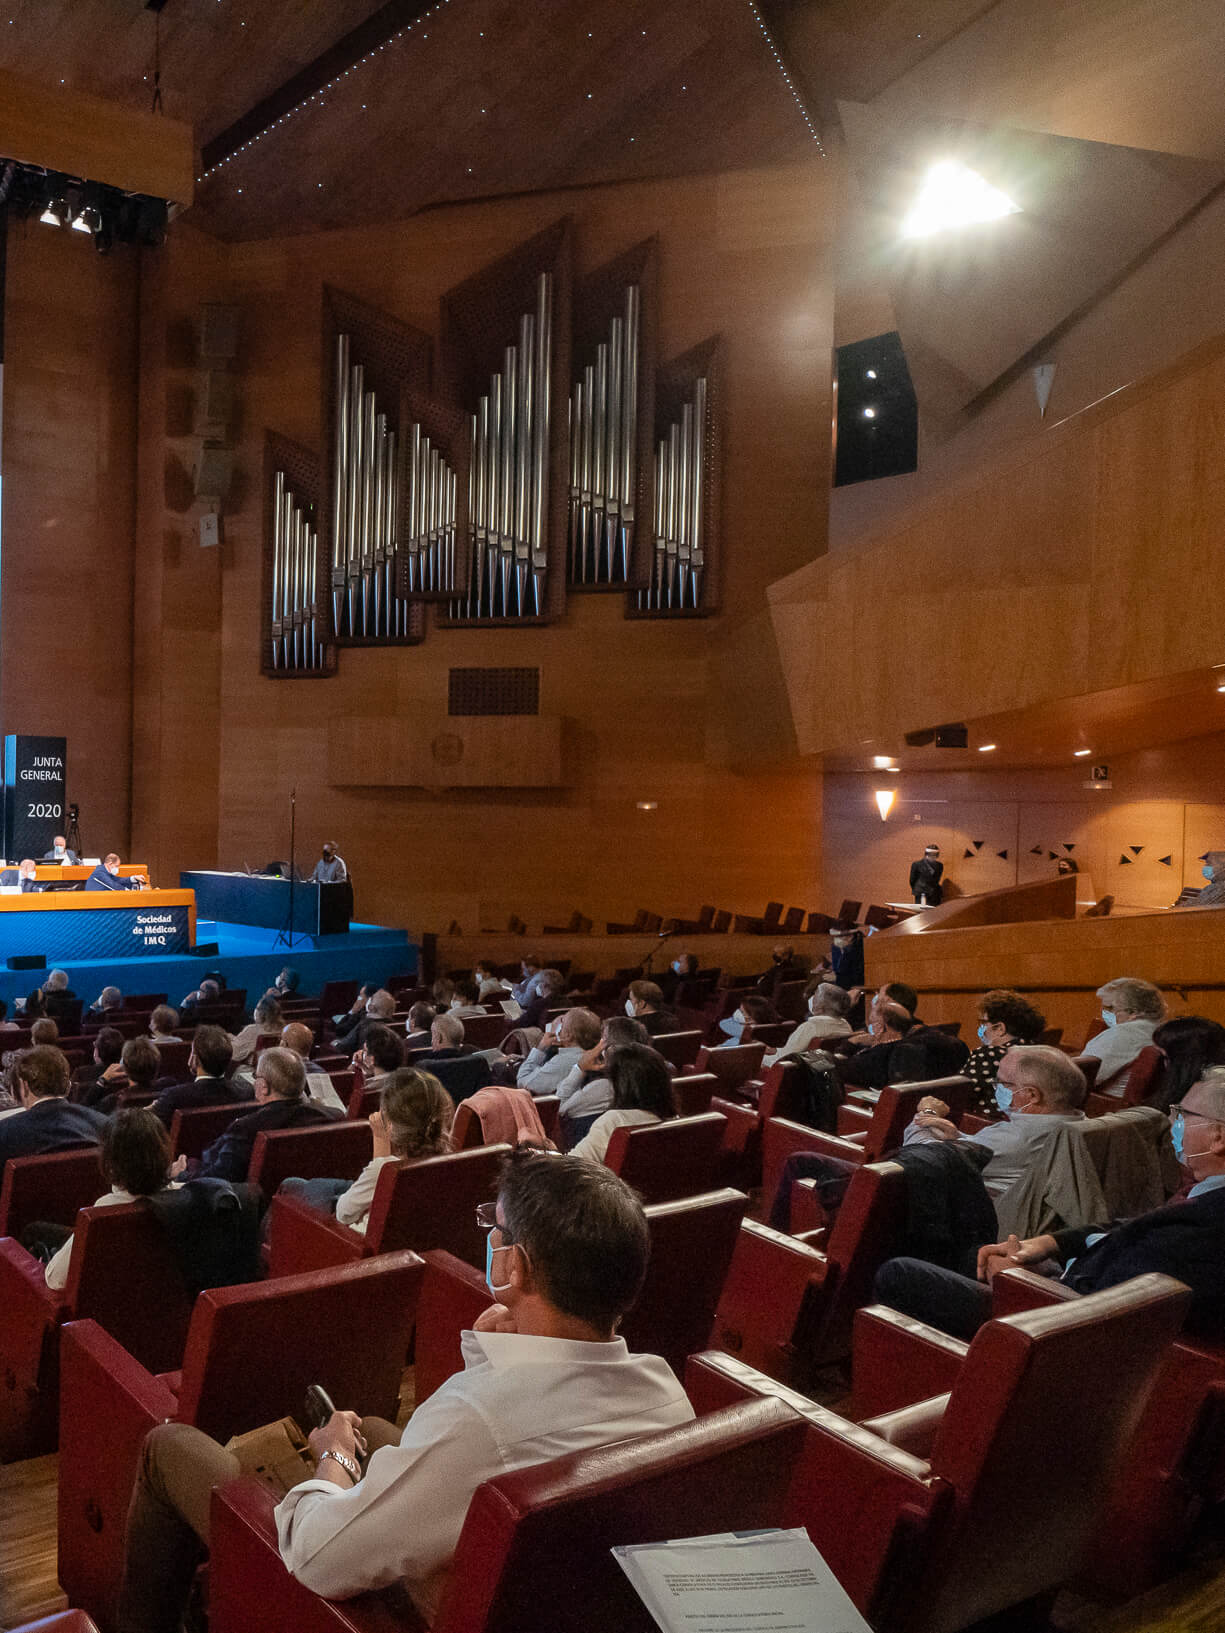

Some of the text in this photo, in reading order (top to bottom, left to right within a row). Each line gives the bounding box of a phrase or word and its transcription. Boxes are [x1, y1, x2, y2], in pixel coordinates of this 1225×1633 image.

[33, 757, 63, 767] JUNTA
[20, 770, 63, 781] GENERAL
[27, 804, 62, 818] 2020
[137, 915, 172, 923] Sociedad
[132, 925, 177, 934] de Médicos
